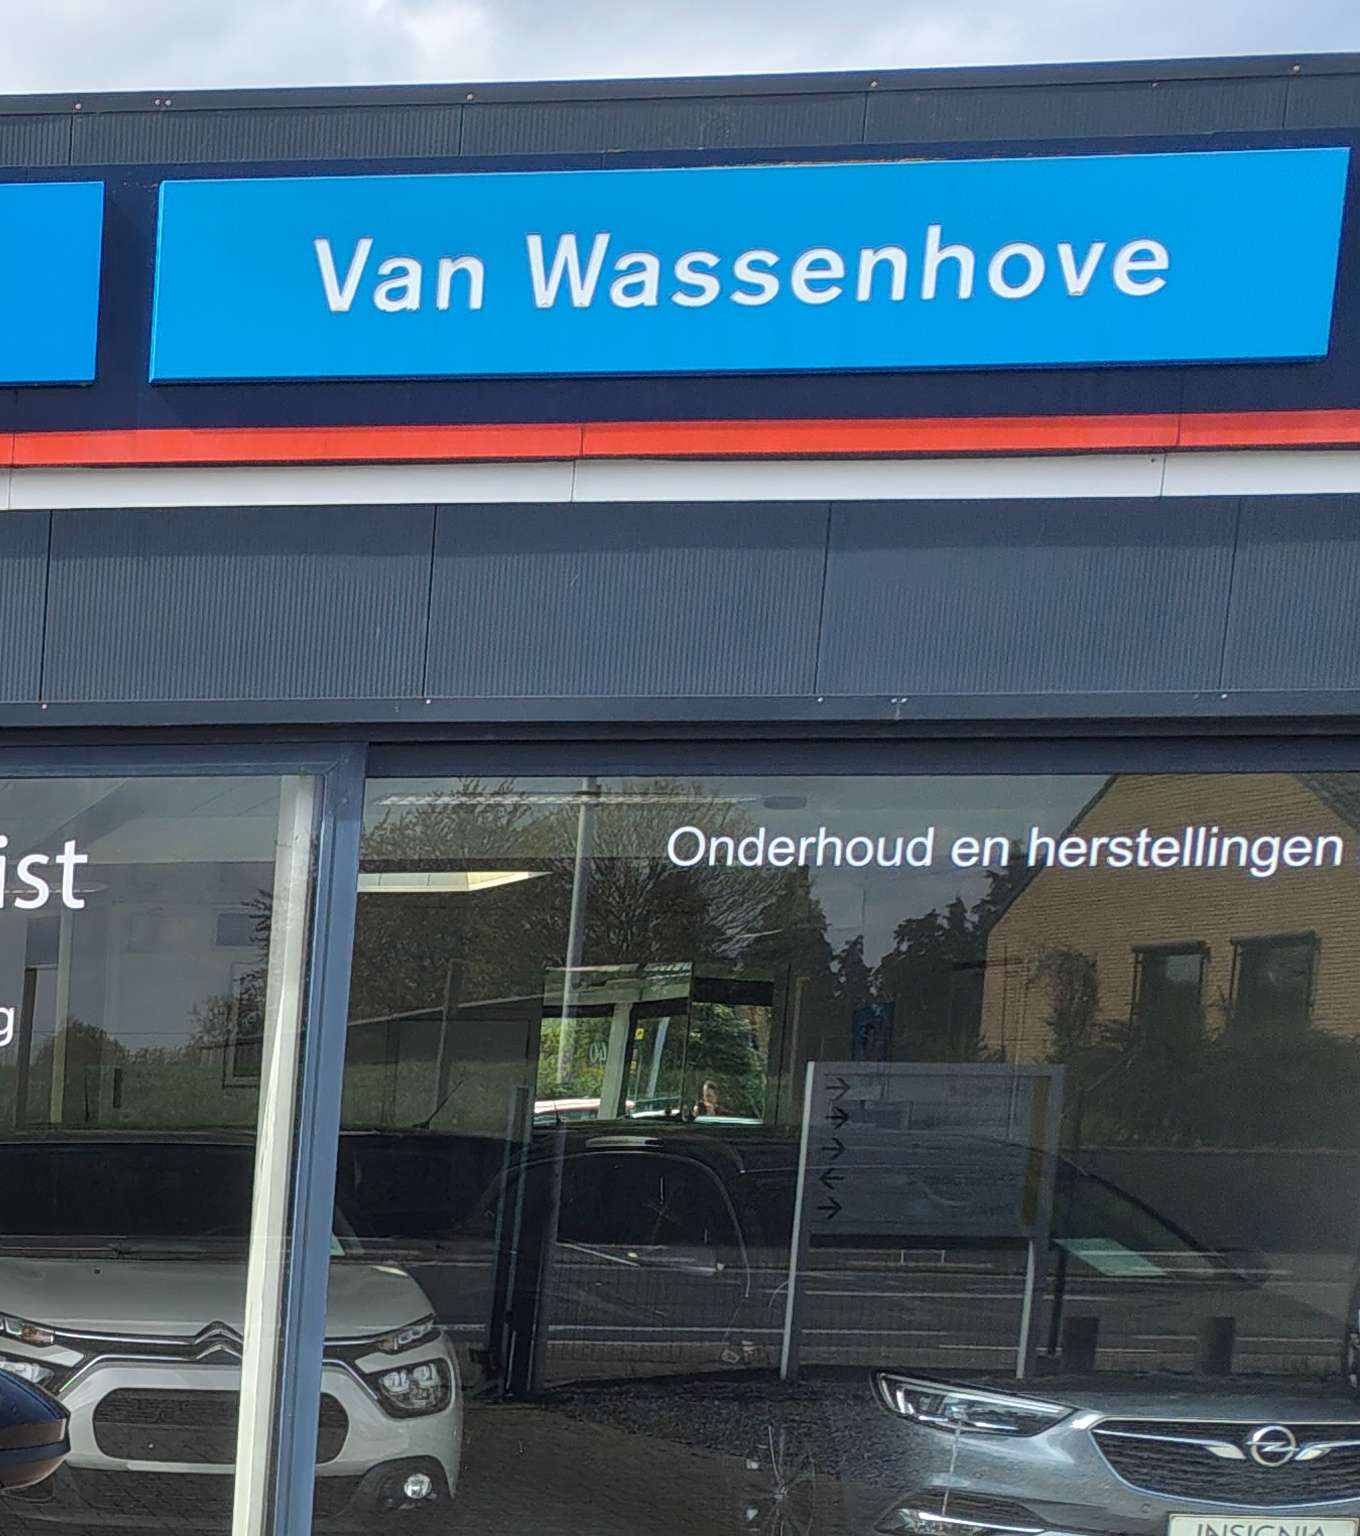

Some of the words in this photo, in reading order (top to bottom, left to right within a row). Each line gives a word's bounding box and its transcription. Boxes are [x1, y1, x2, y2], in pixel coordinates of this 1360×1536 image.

[313, 236, 485, 313] Van
[524, 222, 1171, 309] Wassenhove
[667, 826, 936, 868] Onderhoud
[951, 836, 1011, 868] en
[1028, 826, 1345, 879] herstellingen
